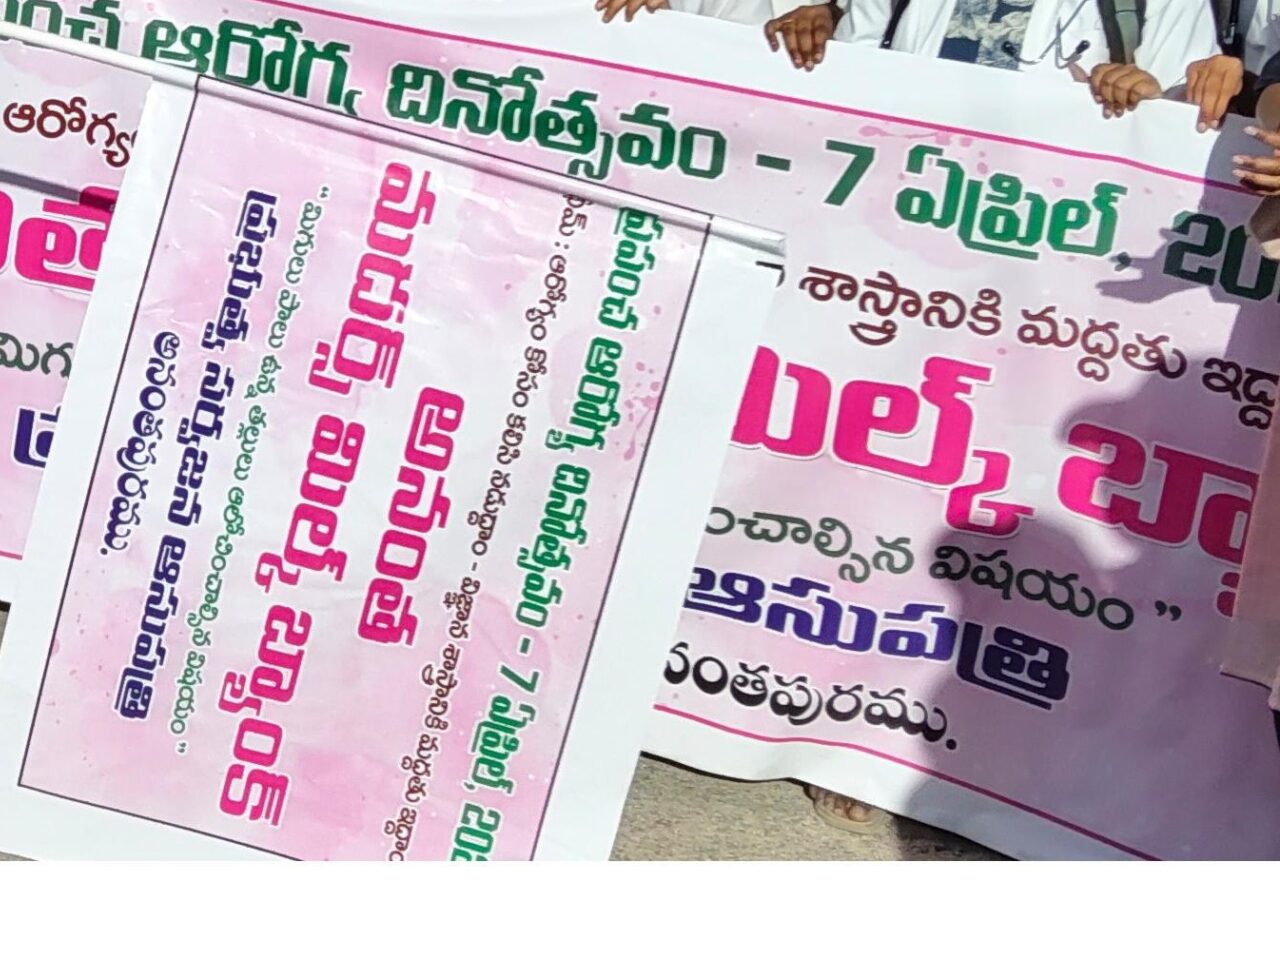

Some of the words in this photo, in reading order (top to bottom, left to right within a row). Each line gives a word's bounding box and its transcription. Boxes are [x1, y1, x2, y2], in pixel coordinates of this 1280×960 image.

[387, 63, 725, 181] దినోత్సవం
[821, 140, 877, 208] 7
[896, 141, 1130, 270] ఏప్రిల్,
[1166, 208, 1280, 303] 20
[199, 188, 278, 352] ప్రభుత్వ
[284, 200, 322, 285] మిగులు
[307, 161, 437, 396] మదర్స్
[524, 253, 567, 341] ఆరోగ్యం
[243, 353, 282, 399] ఉన్న
[267, 288, 301, 349] పాలు
[511, 344, 548, 408] కోసం
[799, 265, 1002, 346] శాస్త్రానికి
[1017, 306, 1188, 382] మద్దతు
[98, 330, 181, 556] అనంతపురము.
[166, 359, 235, 527] సర్వజన
[232, 403, 267, 481] తల్లులు
[495, 411, 527, 466] కలిసి
[543, 335, 623, 453] ఆరోగ్య
[253, 413, 366, 594] మిల్క్
[356, 385, 465, 646] అనంత
[465, 468, 511, 557] నడుద్దాం
[514, 462, 591, 628] దినోత్సవం
[185, 485, 246, 647] ఆలోచించాల్సిన
[705, 506, 914, 583] ంచాల్సిన
[927, 543, 1134, 631] విషయం
[113, 533, 187, 720] ఆసుపత్రి
[498, 664, 540, 693] 7
[169, 649, 206, 735] విషయం
[216, 603, 313, 827] బ్యాంక్
[420, 642, 461, 731] శాస్త్రానికి
[463, 694, 536, 794] ఏప్రిల్,
[399, 732, 439, 803] మద్దతు
